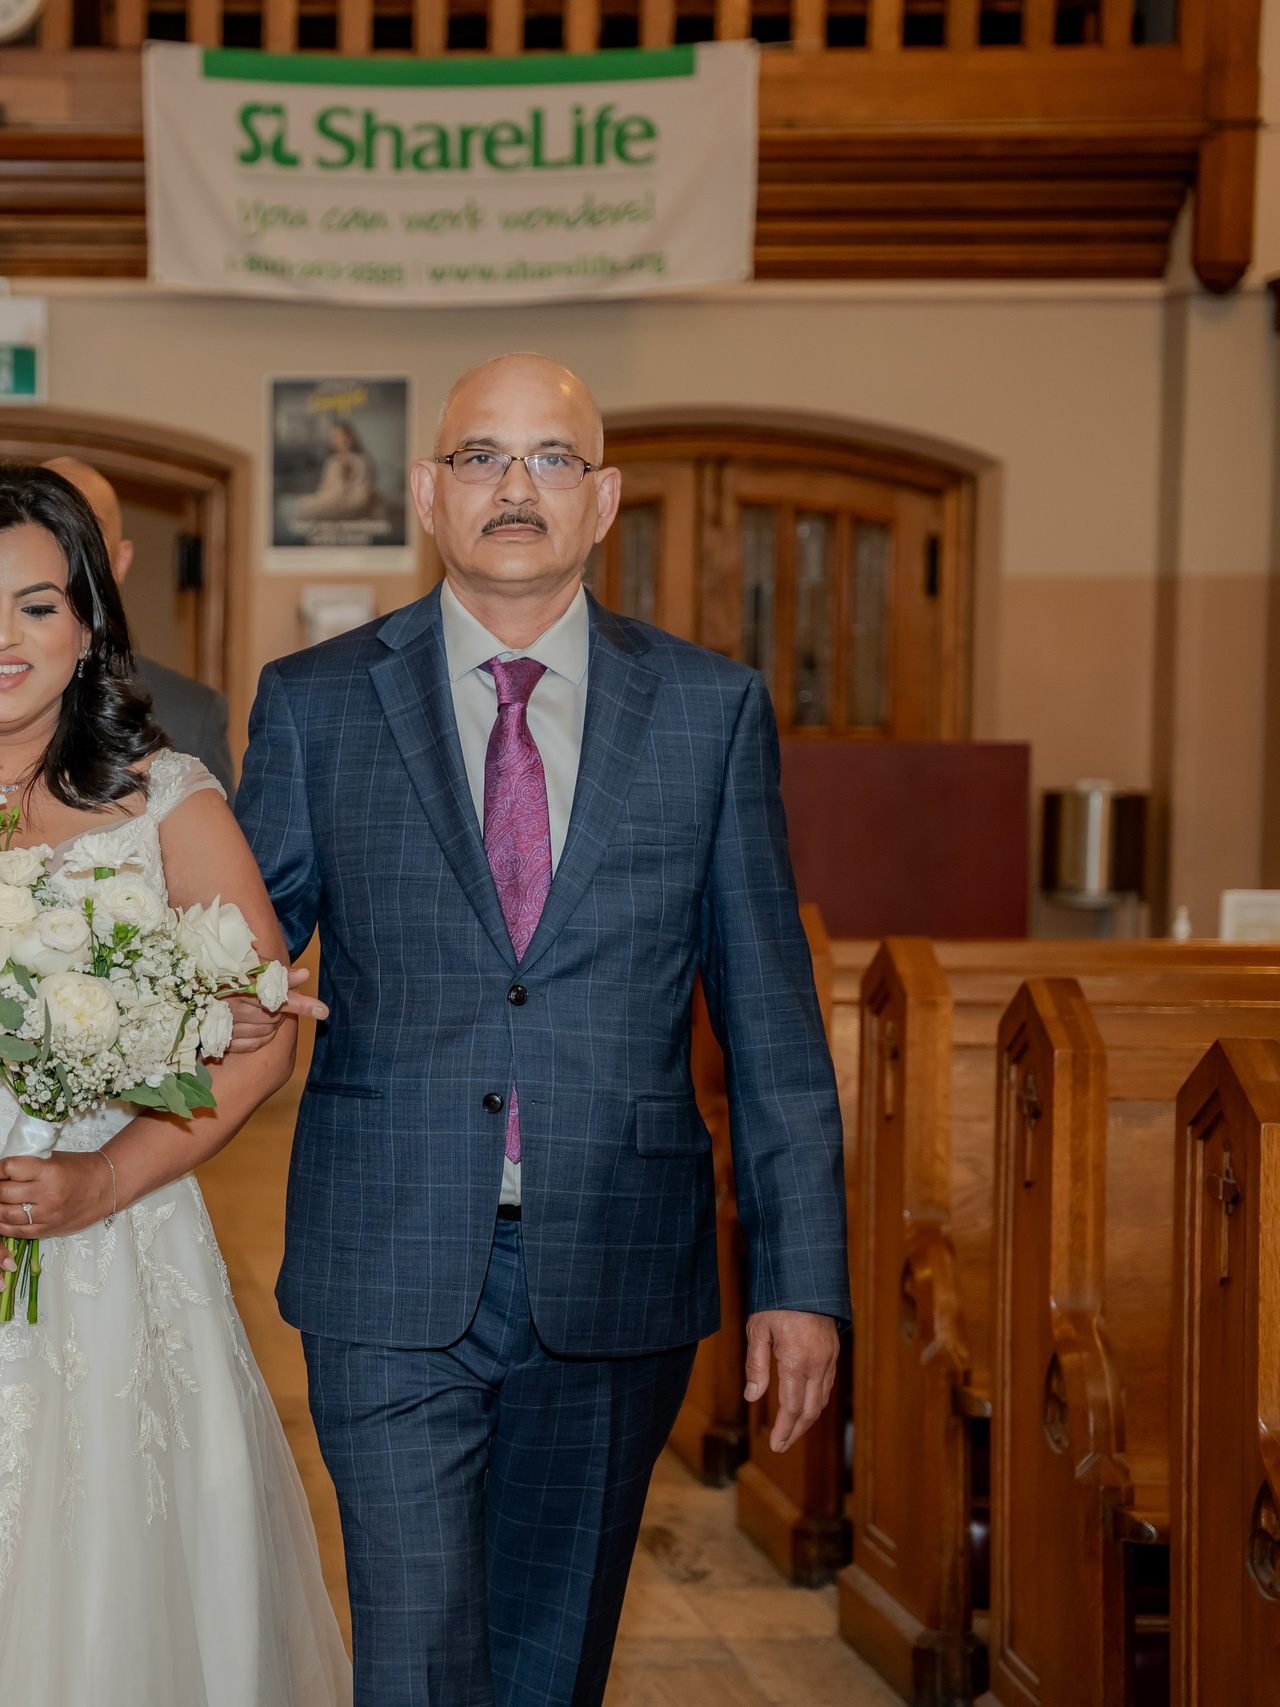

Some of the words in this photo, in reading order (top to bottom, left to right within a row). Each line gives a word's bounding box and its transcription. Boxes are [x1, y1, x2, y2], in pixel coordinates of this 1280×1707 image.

[315, 105, 658, 170] ShareLife
[320, 206, 388, 233] can
[402, 197, 484, 232] work
